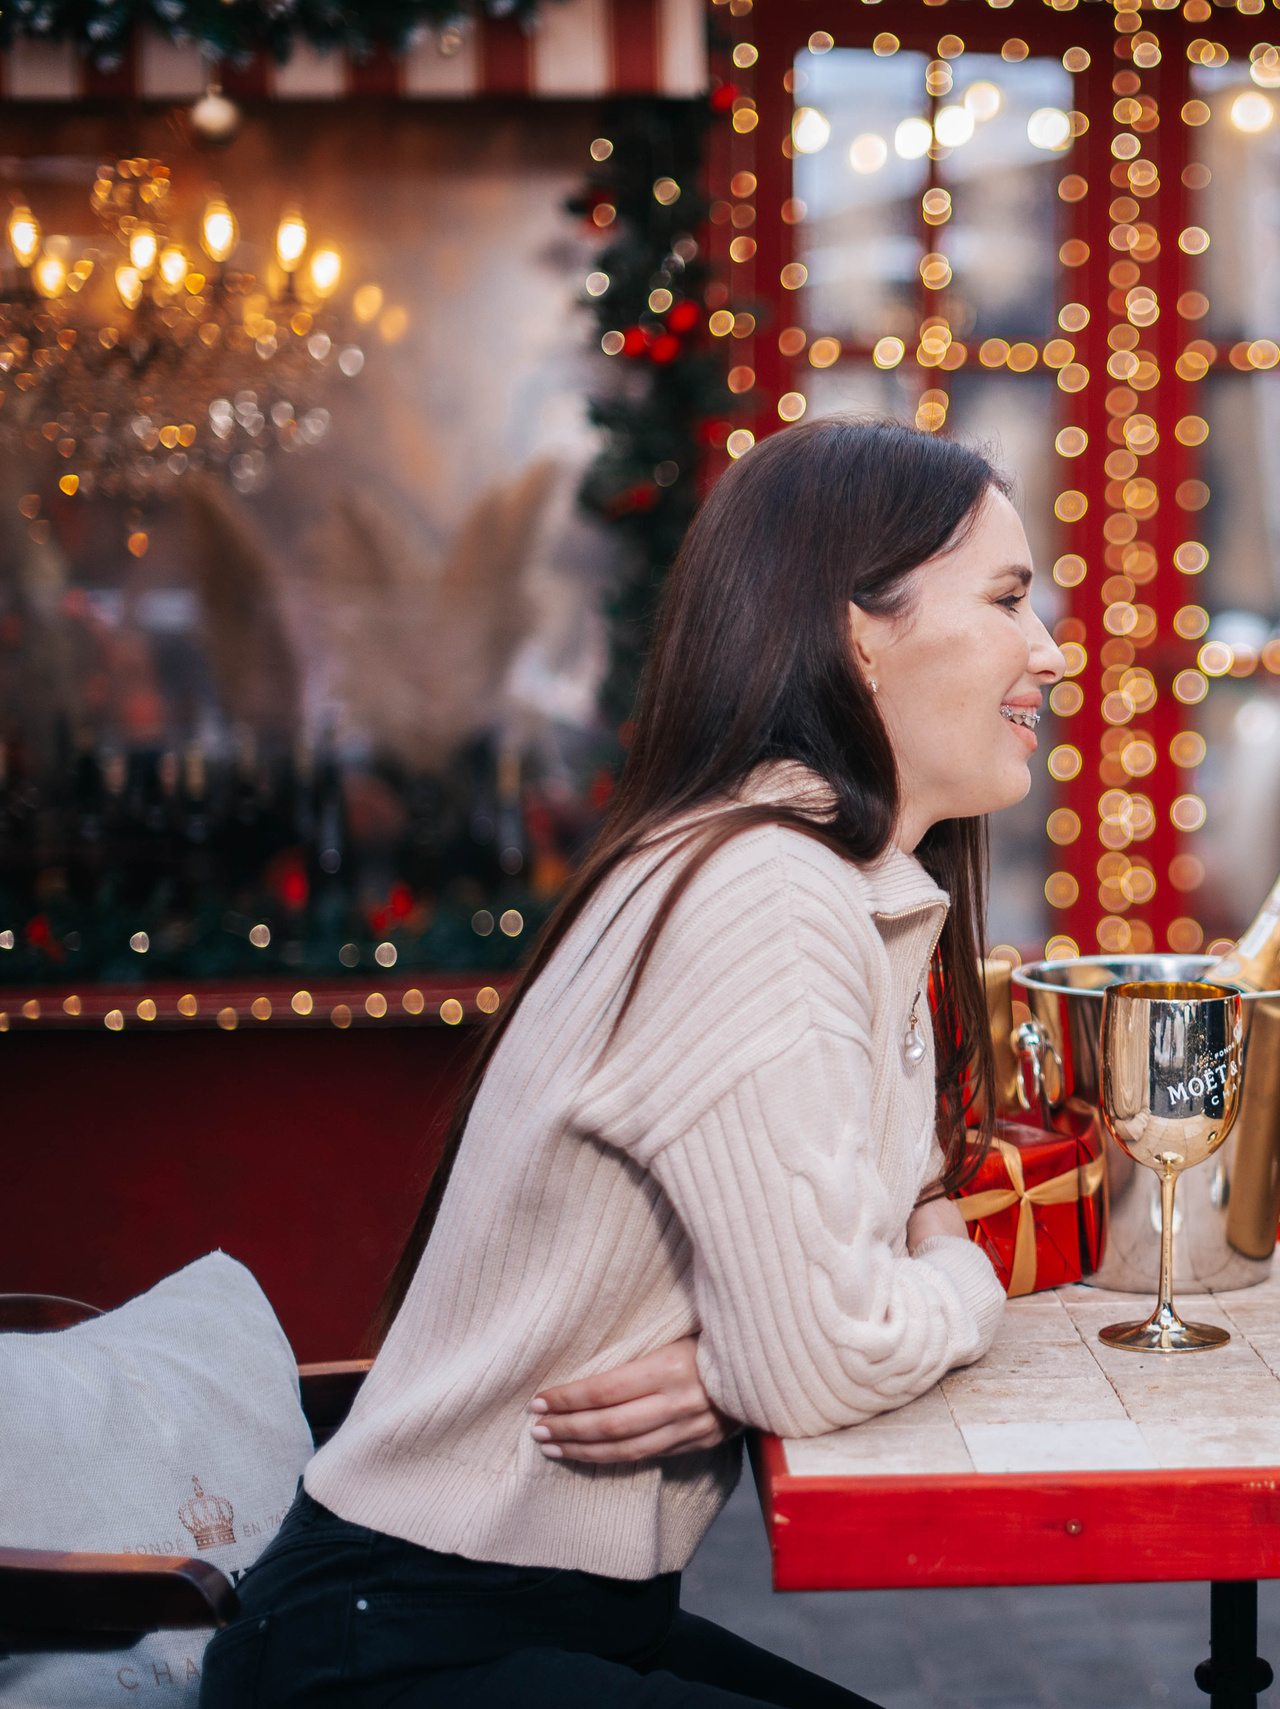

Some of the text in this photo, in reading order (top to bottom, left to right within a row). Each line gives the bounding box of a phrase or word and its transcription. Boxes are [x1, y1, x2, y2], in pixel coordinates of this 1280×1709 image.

[1166, 1063, 1227, 1105] MOËT
[1230, 1060, 1238, 1076] &
[242, 1519, 262, 1538] EN
